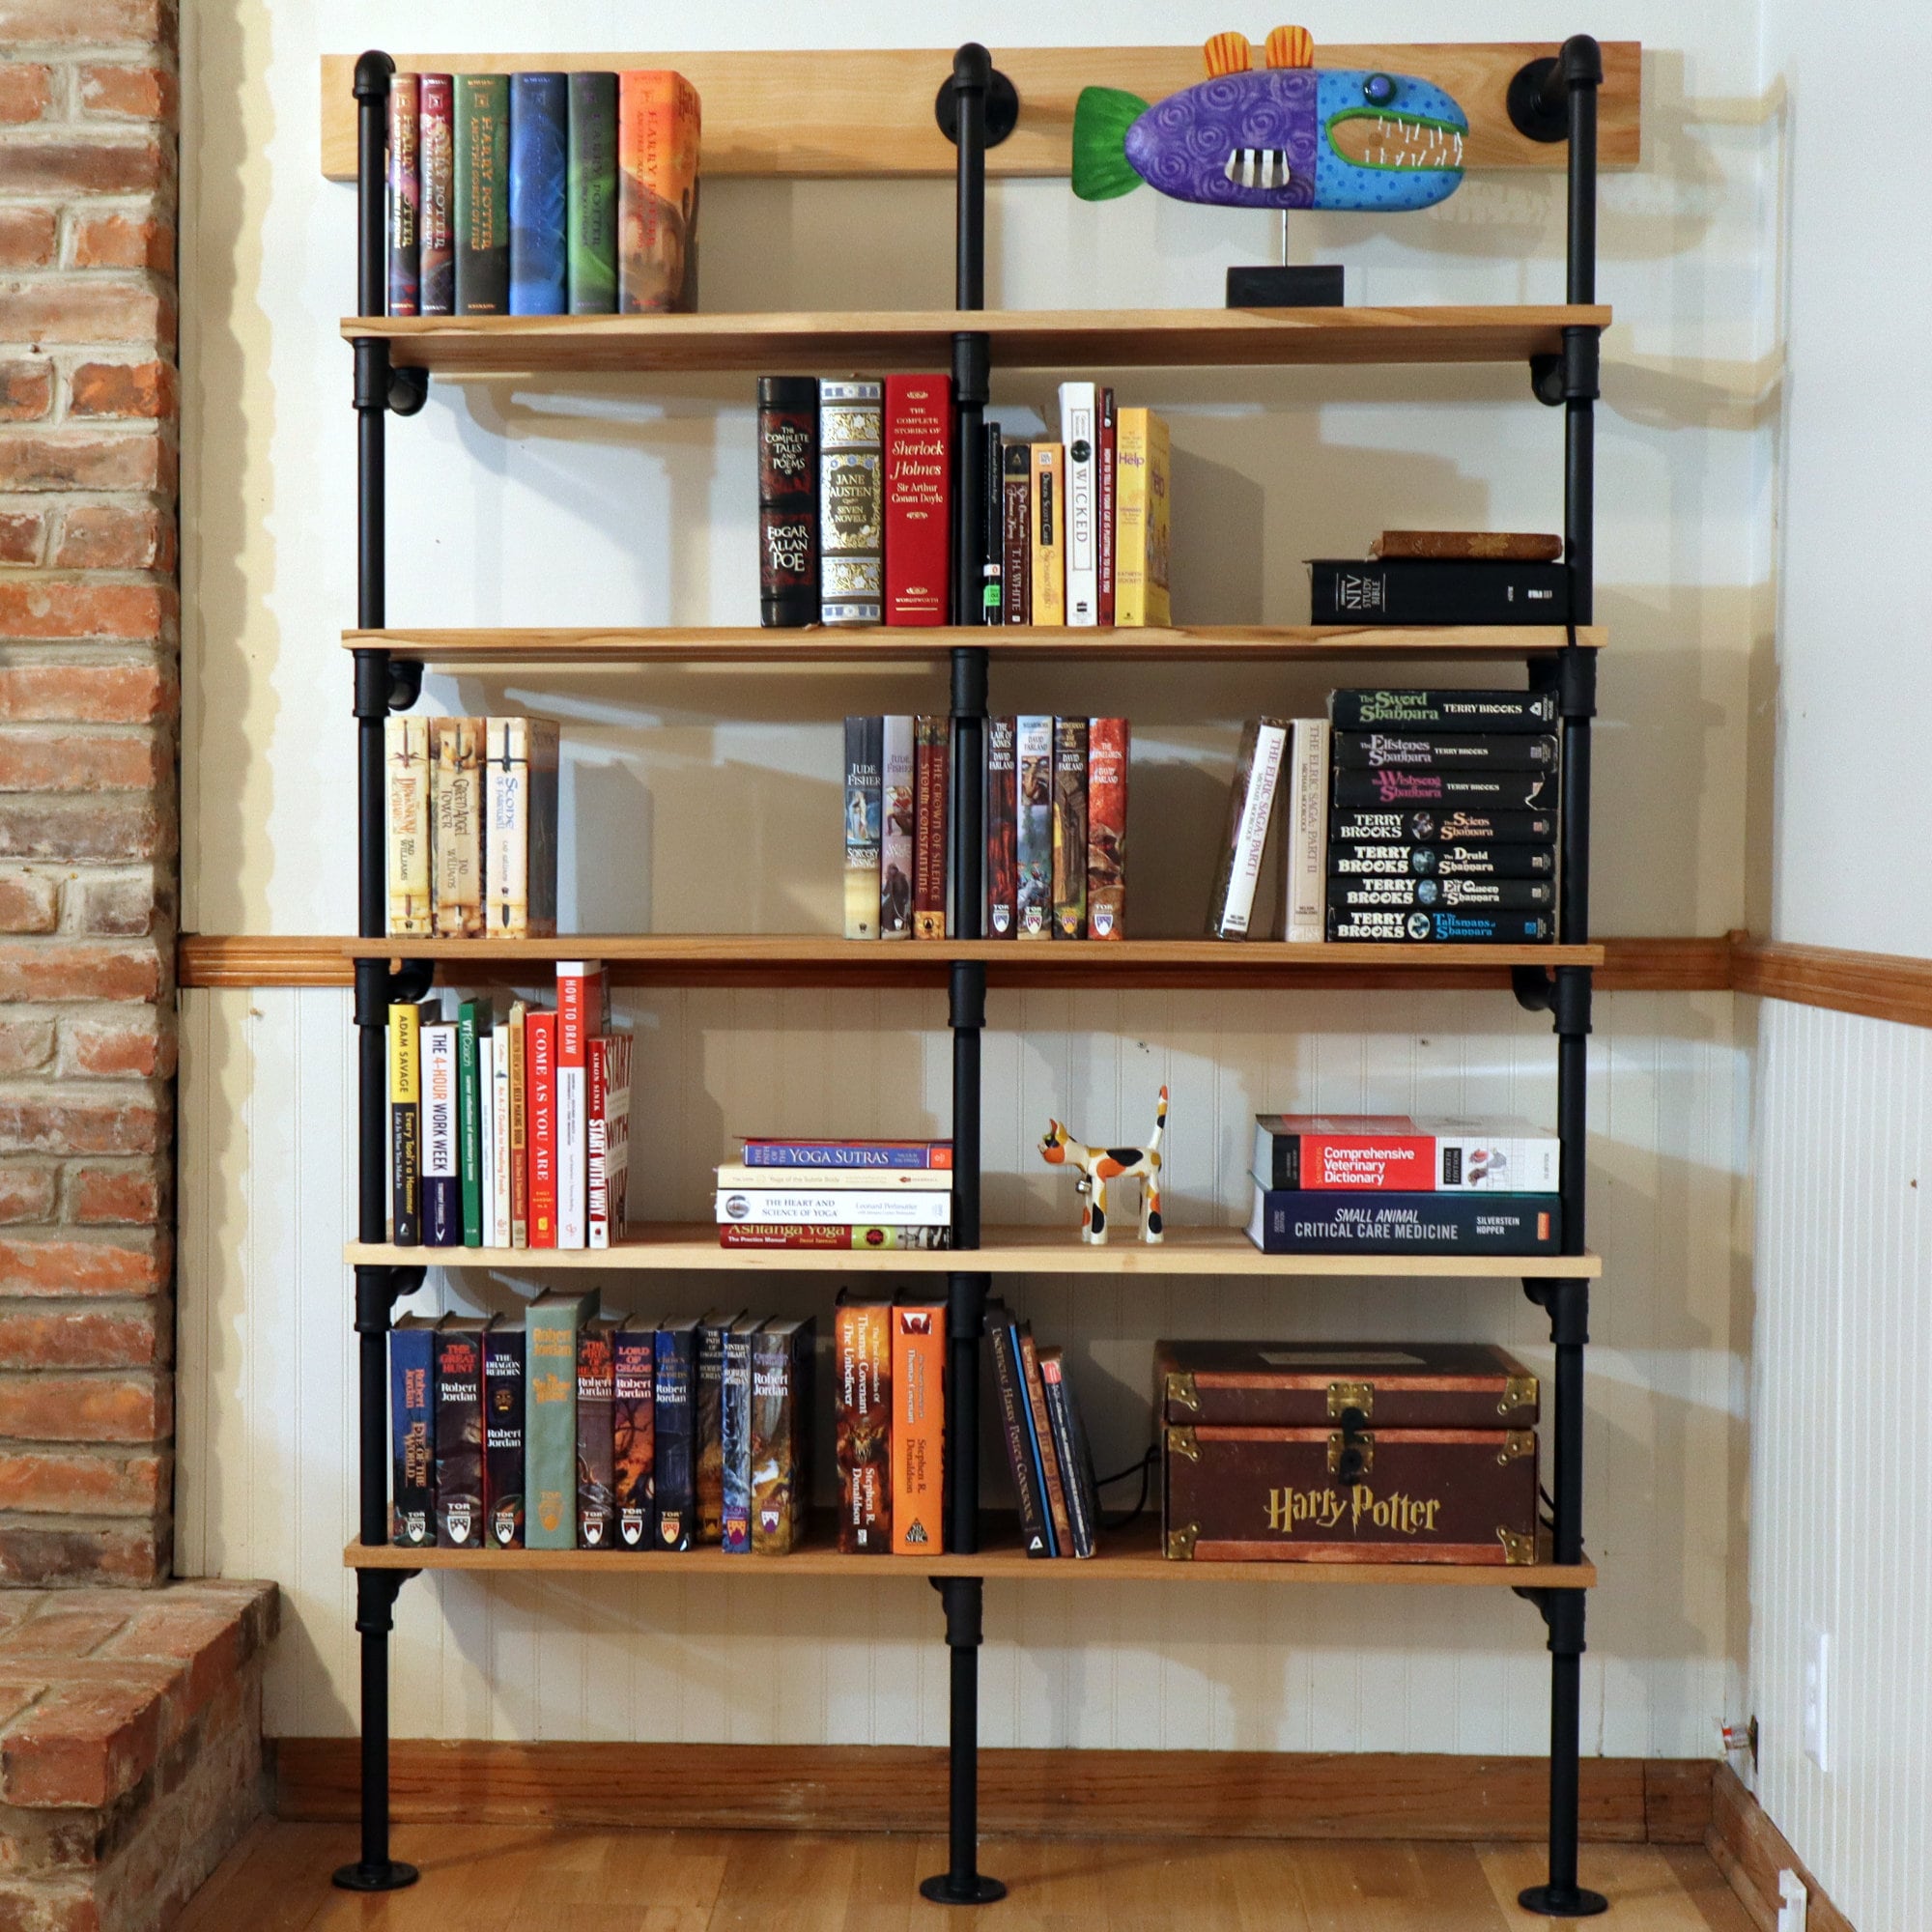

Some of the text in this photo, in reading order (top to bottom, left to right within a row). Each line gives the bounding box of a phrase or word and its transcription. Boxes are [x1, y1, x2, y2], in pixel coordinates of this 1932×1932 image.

[482, 116, 493, 249] HARRY POTTER
[436, 185, 445, 248] POTTER
[592, 185, 602, 246] POTTER
[765, 434, 810, 443] COMPLETE
[775, 443, 802, 453] TALES
[893, 440, 944, 455] Sherlock
[773, 459, 805, 469] POEMS
[1119, 453, 1144, 469] Help
[890, 462, 941, 479] Holmes
[836, 474, 865, 485] JANE
[830, 487, 870, 497] AUSTEN
[897, 483, 937, 492] Sir Arthur
[892, 494, 943, 503] Conan Doyle
[1076, 469, 1087, 542] WICKED
[768, 526, 808, 539] EDGAR
[769, 539, 808, 551] ALLAN
[774, 553, 805, 572] POE
[1347, 575, 1362, 610] NIV
[1363, 578, 1372, 608] STUDY
[1372, 581, 1380, 605] BIBLE
[1376, 692, 1427, 708] Sword
[1443, 704, 1522, 714] TERRY BROOKS
[1309, 725, 1319, 752] THE
[994, 753, 1010, 761] DAVID
[1063, 753, 1080, 762] DAVID
[1268, 739, 1282, 763] THE
[852, 763, 875, 774] JUDE
[989, 761, 1014, 770] FARLAND
[1309, 754, 1319, 789] ELRIC
[848, 775, 881, 785] FISHER
[1262, 766, 1279, 797] ELRIC
[1309, 794, 1318, 828] SAGA:
[1253, 801, 1268, 836] SAGA:
[1353, 814, 1404, 826] TERRY
[1341, 827, 1402, 838] BROOKS
[1308, 831, 1317, 860] PART
[847, 847, 879, 859] SORCERY
[1248, 839, 1262, 867] PART
[1354, 846, 1410, 859] TERRY
[1339, 860, 1409, 872] BROOKS
[1363, 879, 1415, 891] TERRY
[1347, 892, 1413, 904] BROOKS
[1351, 913, 1405, 924] TERRY
[1434, 913, 1490, 926] Talismans
[1338, 925, 1405, 938] BROOKS
[565, 980, 577, 1054] HOW TO DRAW
[399, 1015, 409, 1093] ADAM SAVAGE
[432, 1034, 447, 1171] THE 4-HOUR WORK WEEK
[536, 1029, 548, 1180] COME AS YOU ARE
[405, 1112, 413, 1137] Every
[405, 1141, 414, 1165] Tool's
[789, 1149, 831, 1162] YOGA
[835, 1150, 889, 1164] SUTRAS
[1323, 1147, 1415, 1159] Comprehensive
[589, 1119, 605, 1215] START WITH WHY
[1323, 1159, 1385, 1174] Veterinary
[1323, 1171, 1384, 1184] Dictionary
[1335, 1208, 1418, 1223] SMALL ANIMAL
[1477, 1216, 1520, 1226] SILVERSTEIN
[1294, 1223, 1459, 1239] CRITICAL CARE MEDICINE
[1476, 1226, 1504, 1236] HOPPER
[447, 1345, 469, 1353] THE
[440, 1354, 474, 1364] GREAT
[843, 1323, 854, 1406] The Unbeliever
[858, 1315, 868, 1413] Thomas Covenant
[579, 1378, 611, 1387] Robert
[616, 1378, 650, 1388] Robert
[754, 1373, 787, 1384] Robert
[441, 1383, 476, 1393] Robert
[579, 1387, 611, 1396] Jordan
[616, 1389, 650, 1398] Jordan
[657, 1384, 686, 1393] Robert
[754, 1384, 787, 1396] Jordan
[441, 1392, 476, 1401] Jordan
[487, 1429, 521, 1438] Robert
[487, 1438, 521, 1447] Jordan
[917, 1439, 925, 1493] Stephen R.
[853, 1468, 862, 1524] Donaldson
[866, 1468, 875, 1525] Stephen R.
[1263, 1484, 1440, 1534] Harry Potter
